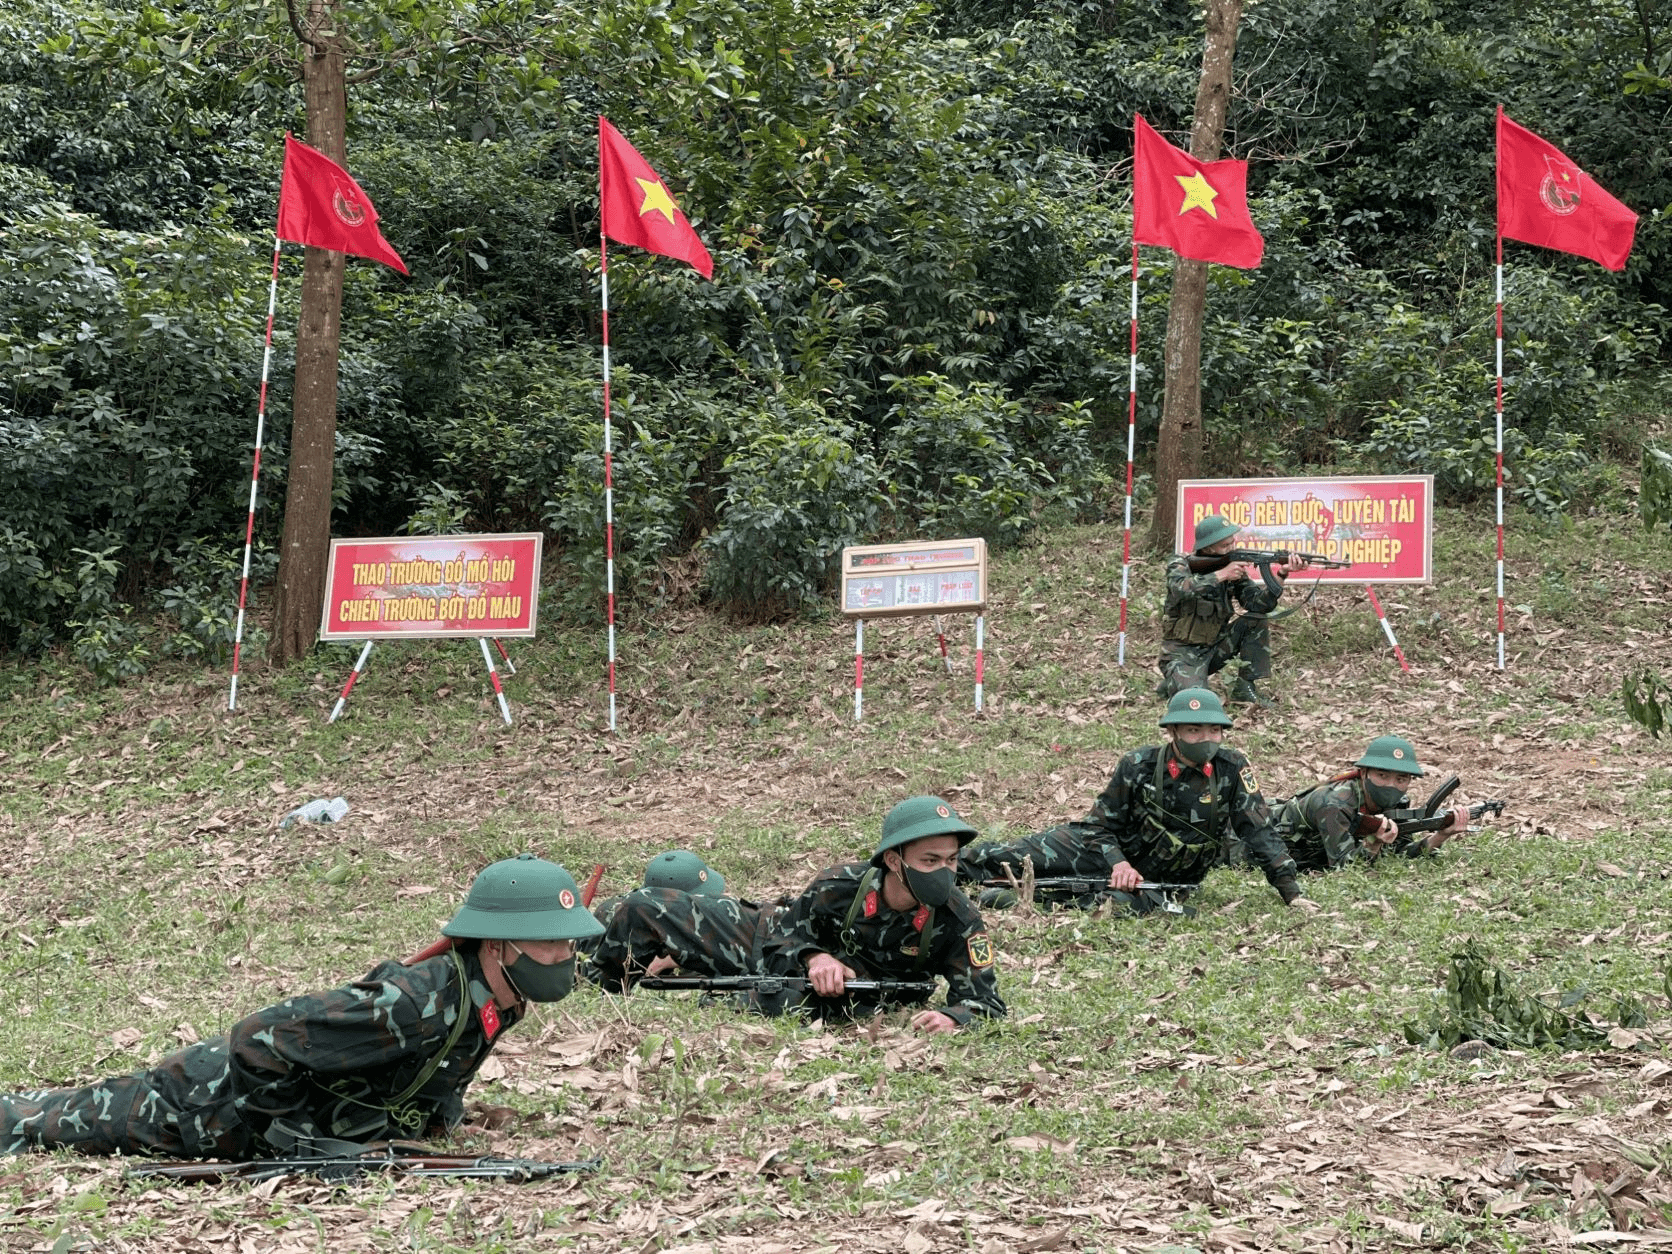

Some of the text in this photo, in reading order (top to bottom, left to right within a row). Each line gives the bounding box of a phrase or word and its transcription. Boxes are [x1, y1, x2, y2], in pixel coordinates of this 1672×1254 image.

[1193, 491, 1415, 529] RA SỨC RÈN ĐỨC, LUYỆN TÀI
[352, 551, 515, 585] THAO TRƯỜNG ĐỔ MỒ HÔI
[1341, 534, 1402, 568] NGHIỆP
[339, 589, 521, 622] CHIẾN TRƯỜNG BỚT ĐỔ MÁU
